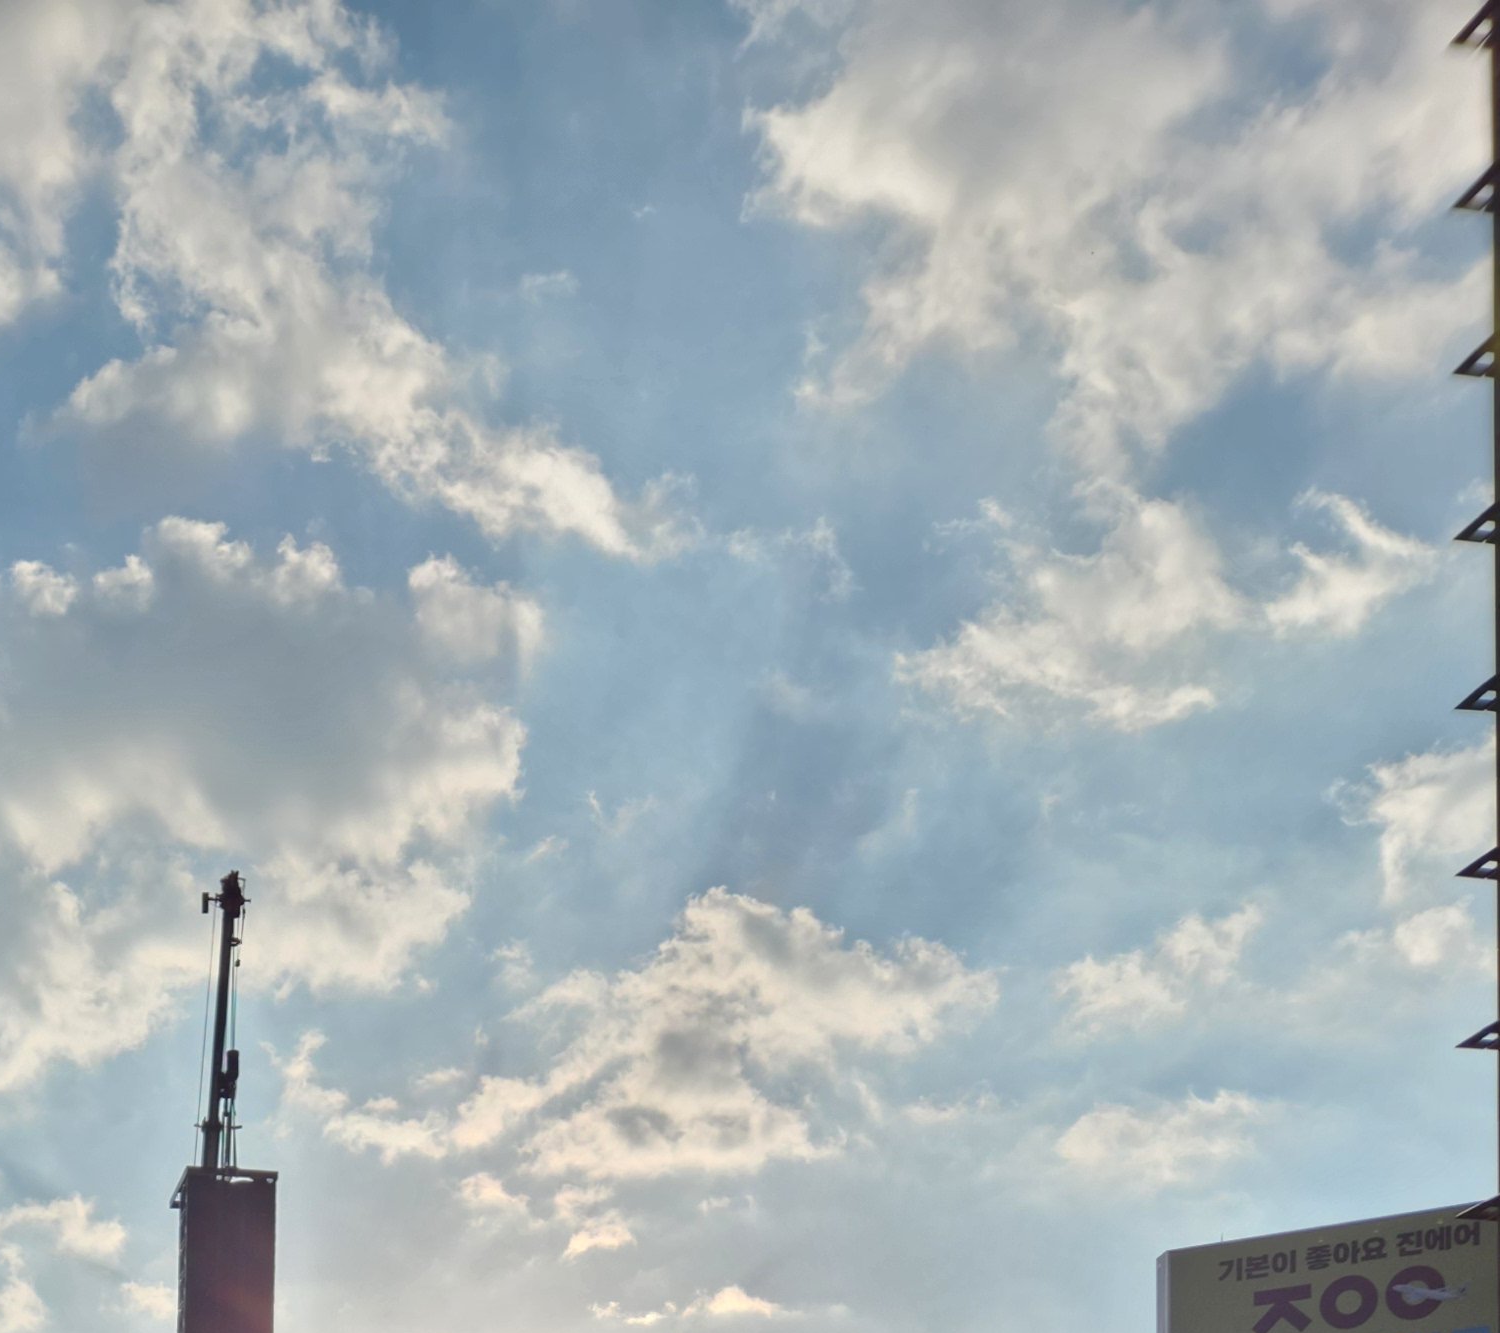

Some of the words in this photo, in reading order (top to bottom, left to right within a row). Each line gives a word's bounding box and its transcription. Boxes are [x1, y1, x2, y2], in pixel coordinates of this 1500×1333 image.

[1218, 1250, 1297, 1281] 기본이
[1305, 1236, 1387, 1271] 좋아요
[1395, 1221, 1481, 1257] 진에어
